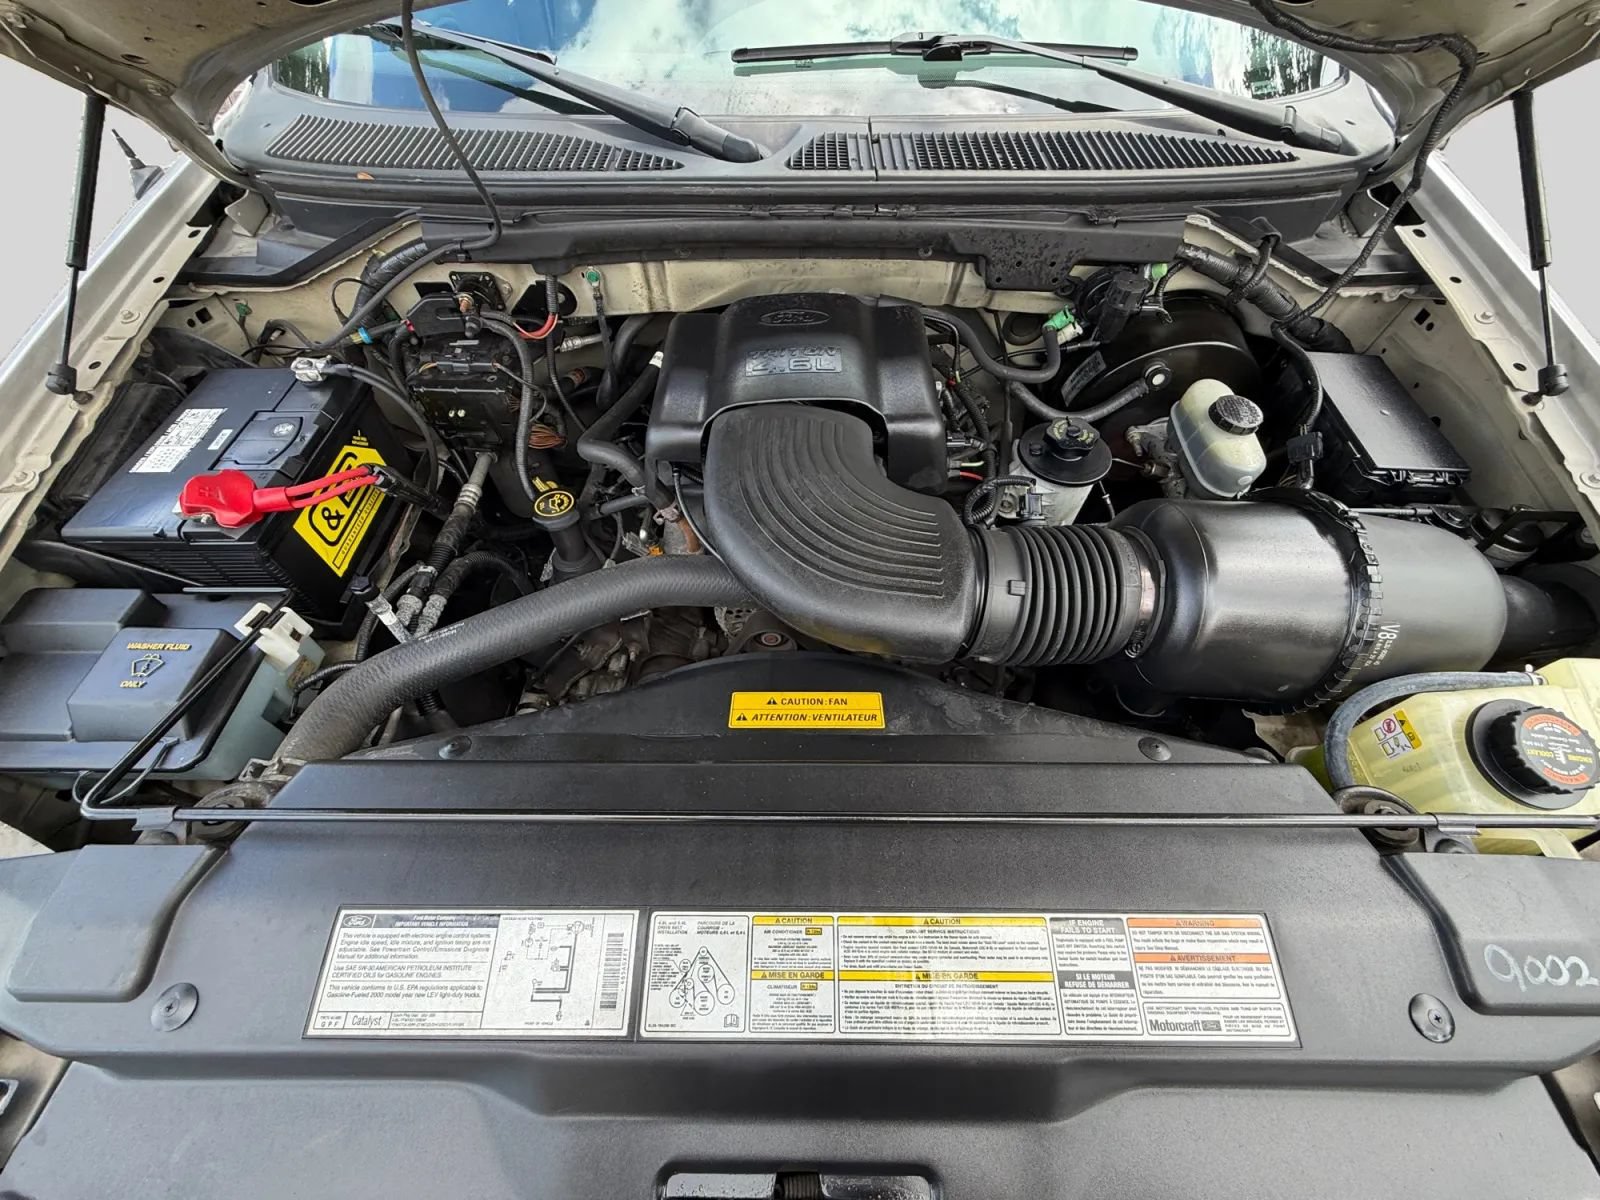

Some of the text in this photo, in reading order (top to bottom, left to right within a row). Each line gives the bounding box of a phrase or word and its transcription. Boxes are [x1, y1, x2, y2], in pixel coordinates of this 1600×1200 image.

[1378, 624, 1400, 640] V8
[352, 1015, 382, 1028] Catalyst
[1149, 1019, 1201, 1032] Motorcraft
